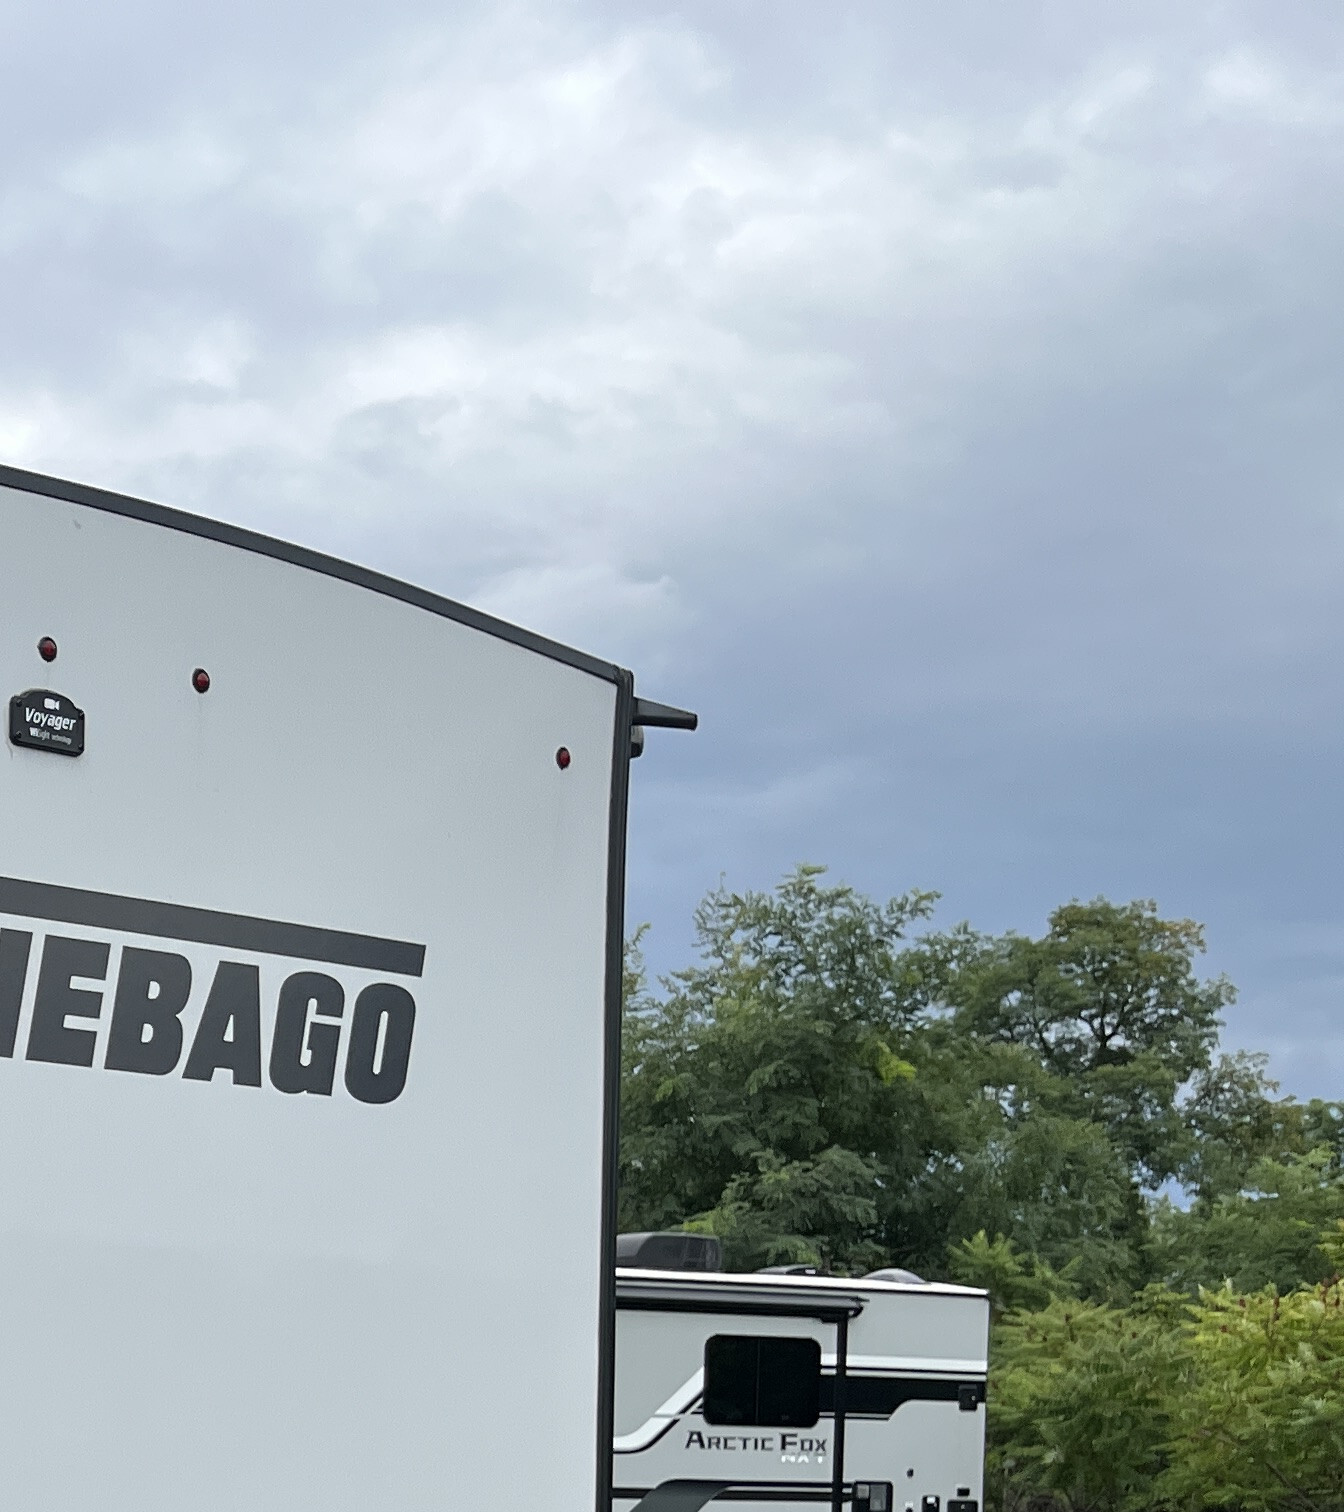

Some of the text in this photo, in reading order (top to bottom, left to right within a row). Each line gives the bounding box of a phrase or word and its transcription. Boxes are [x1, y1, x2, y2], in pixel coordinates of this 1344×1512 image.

[25, 707, 76, 731] Voyager
[685, 1430, 828, 1452] ARCTIC FOX
